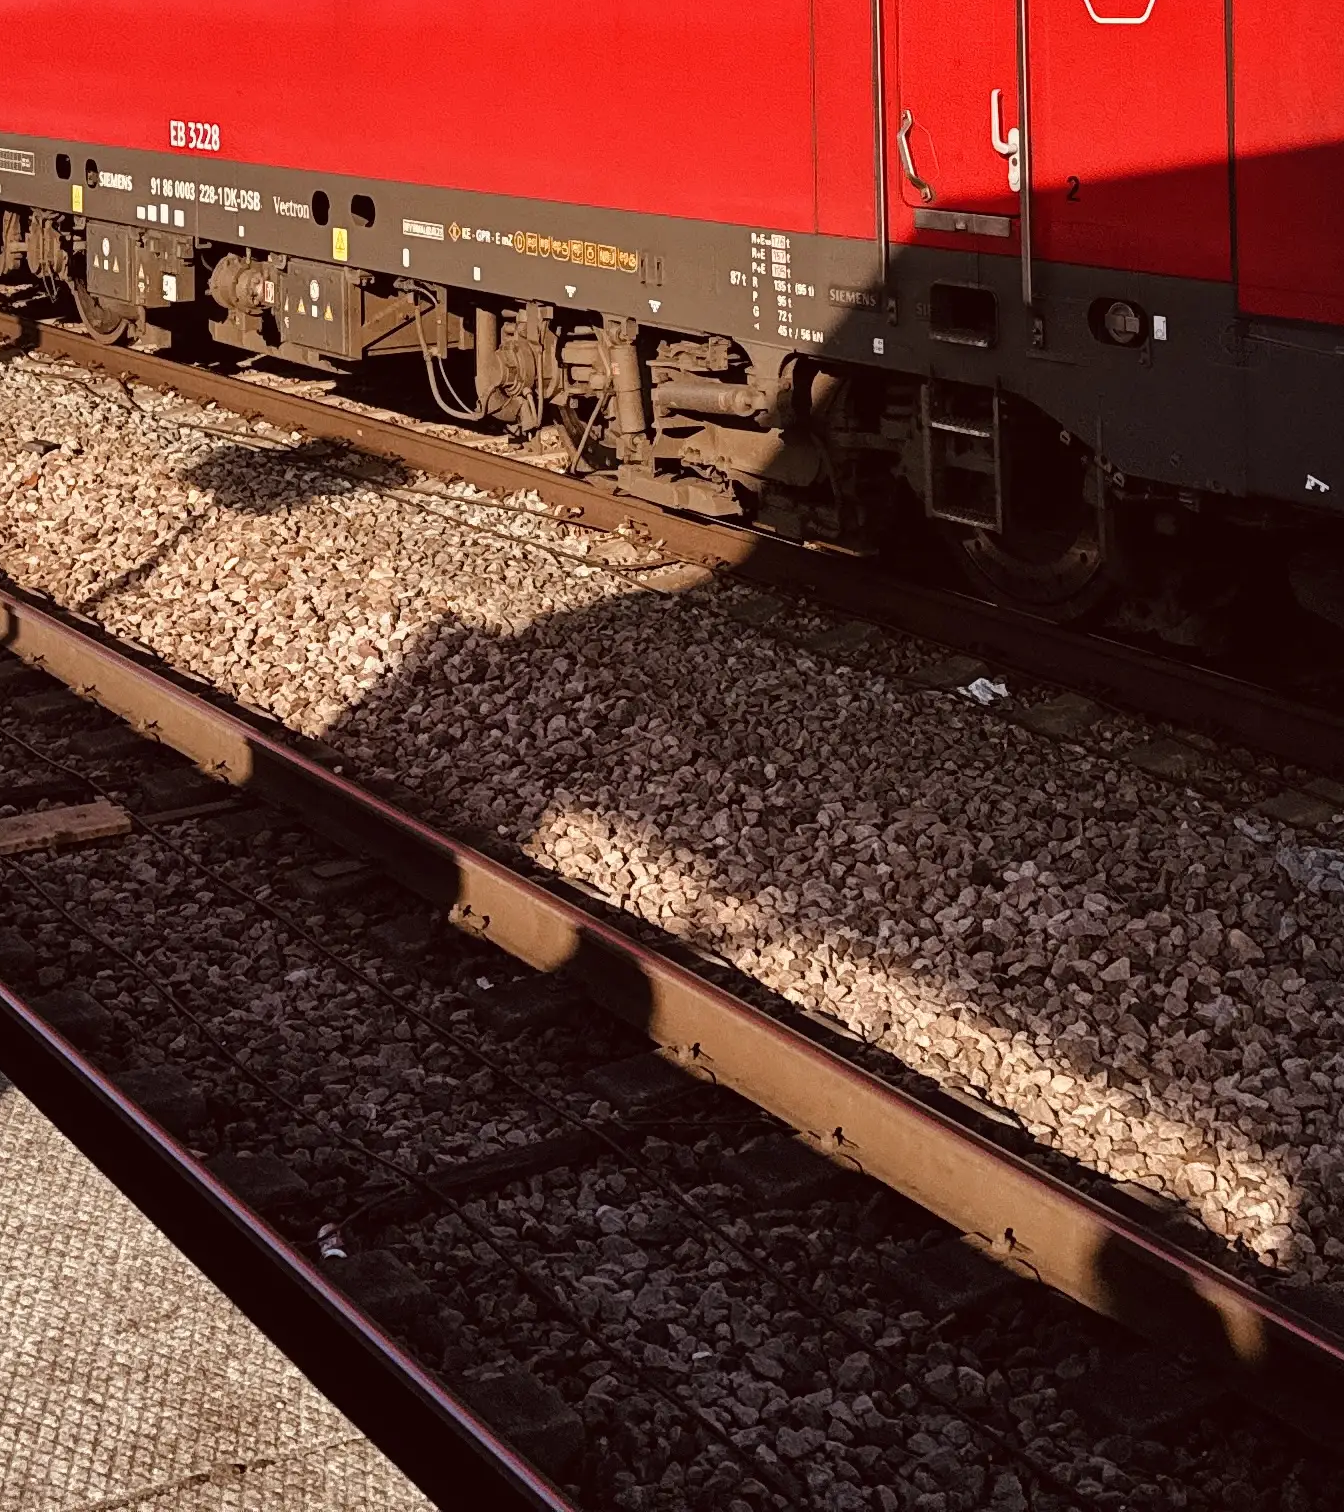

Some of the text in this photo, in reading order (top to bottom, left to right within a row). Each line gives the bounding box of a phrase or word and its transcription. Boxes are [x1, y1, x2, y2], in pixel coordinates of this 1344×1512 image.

[169, 119, 221, 152] EB 3228
[98, 170, 133, 192] SIEMENS
[150, 177, 161, 196] 91
[162, 179, 174, 199] 86
[174, 180, 196, 202] 0003
[1066, 175, 1081, 203] 2
[272, 195, 311, 220] Vectron
[829, 288, 877, 307] SIEMENS
